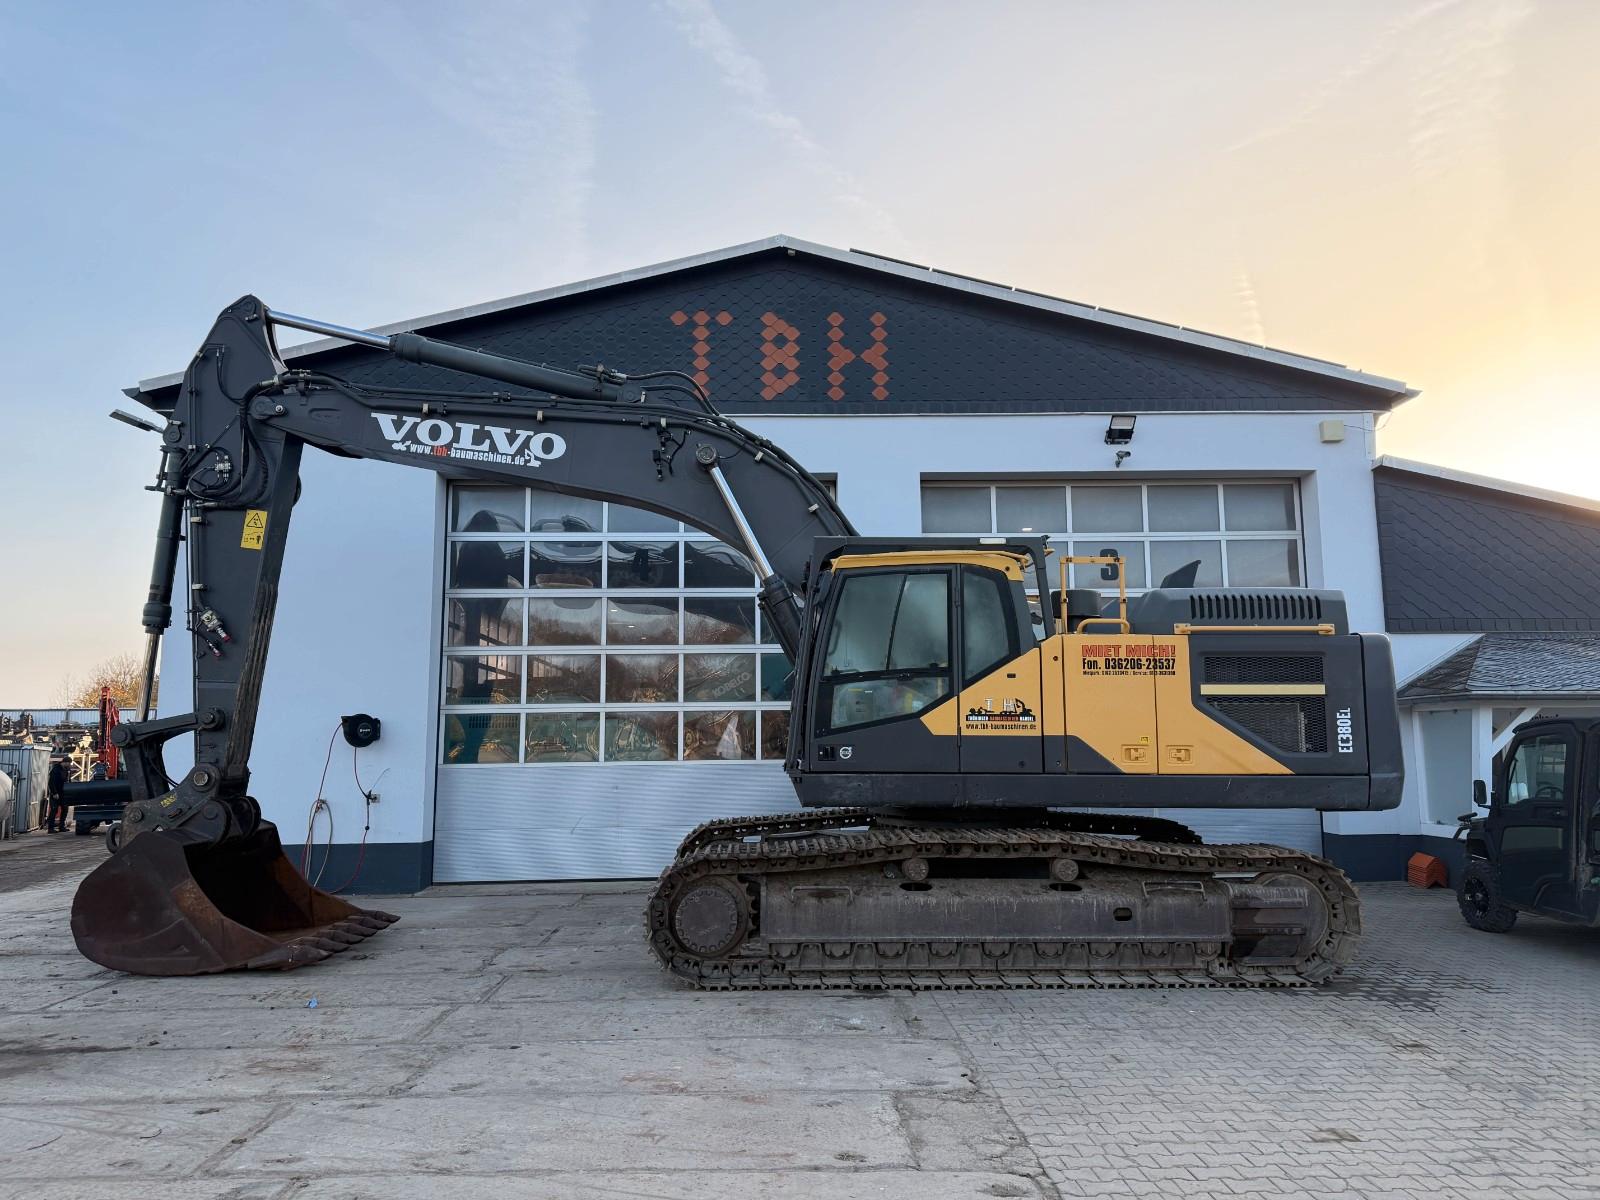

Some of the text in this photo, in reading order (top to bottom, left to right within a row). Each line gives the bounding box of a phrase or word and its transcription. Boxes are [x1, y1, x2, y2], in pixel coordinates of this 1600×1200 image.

[670, 310, 889, 401] TBH
[371, 412, 567, 460] VOLVO
[409, 443, 525, 466] www.tbh-baumaschinen.de
[1100, 549, 1120, 581] 3
[1082, 645, 1176, 657] MIET MICH!
[1082, 658, 1176, 670] Fon. 036206-23537
[1336, 707, 1353, 753] EC380EL
